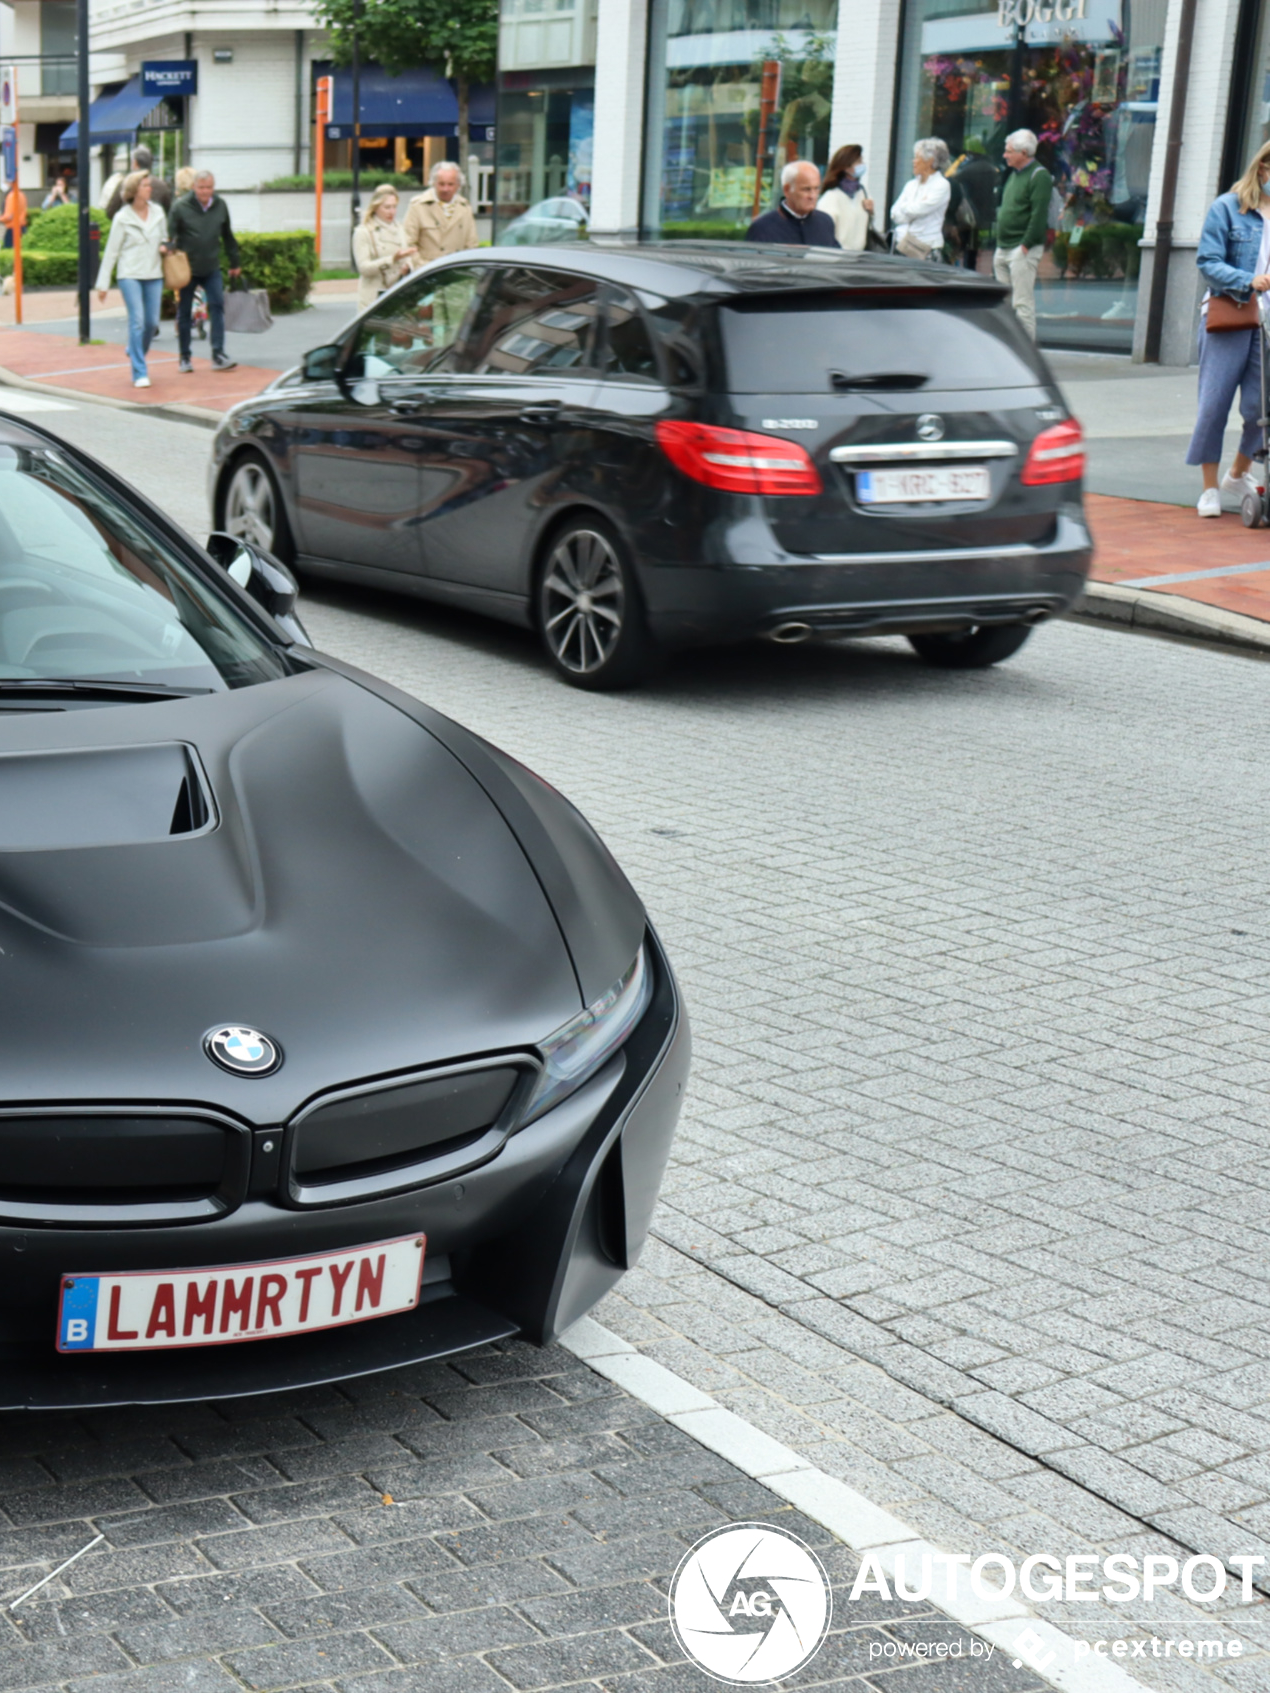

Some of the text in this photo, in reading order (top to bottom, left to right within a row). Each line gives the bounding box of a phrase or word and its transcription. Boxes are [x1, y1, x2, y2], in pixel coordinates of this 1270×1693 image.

[996, 0, 1087, 27] BOGGI
[145, 71, 192, 81] HACKETT
[66, 1253, 386, 1342] B LAMMRTYN
